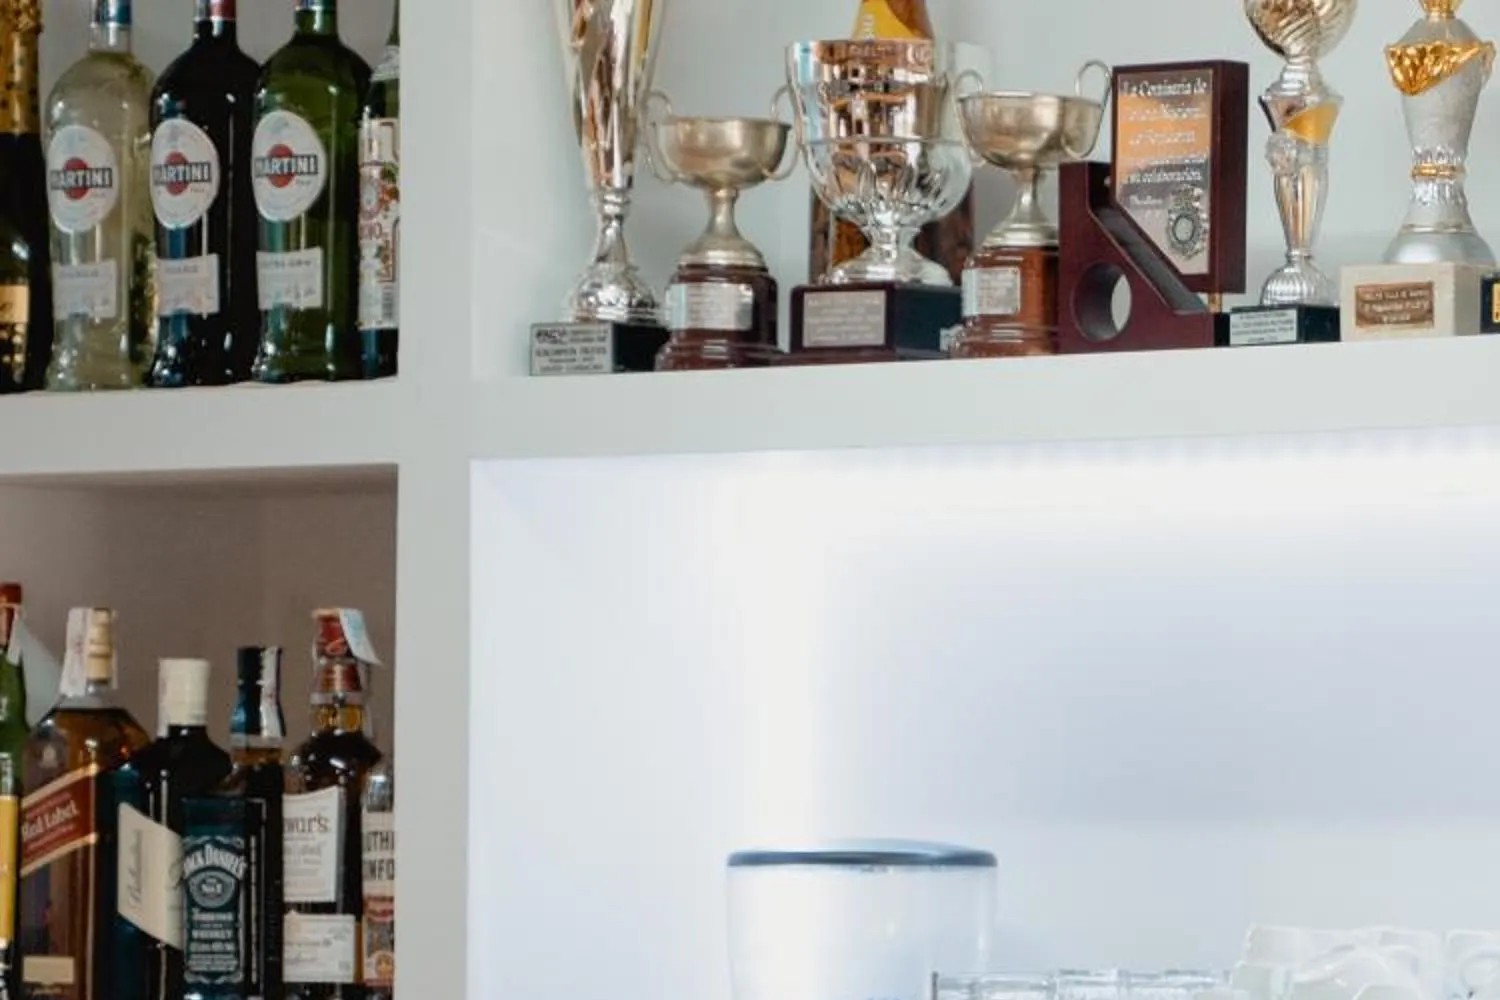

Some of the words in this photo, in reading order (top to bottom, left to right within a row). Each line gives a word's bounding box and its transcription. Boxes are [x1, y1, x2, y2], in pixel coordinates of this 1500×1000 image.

[154, 161, 210, 185] MARTINI
[255, 154, 318, 178] MARTINI
[51, 167, 112, 189] MARTINI
[284, 812, 329, 834] war's
